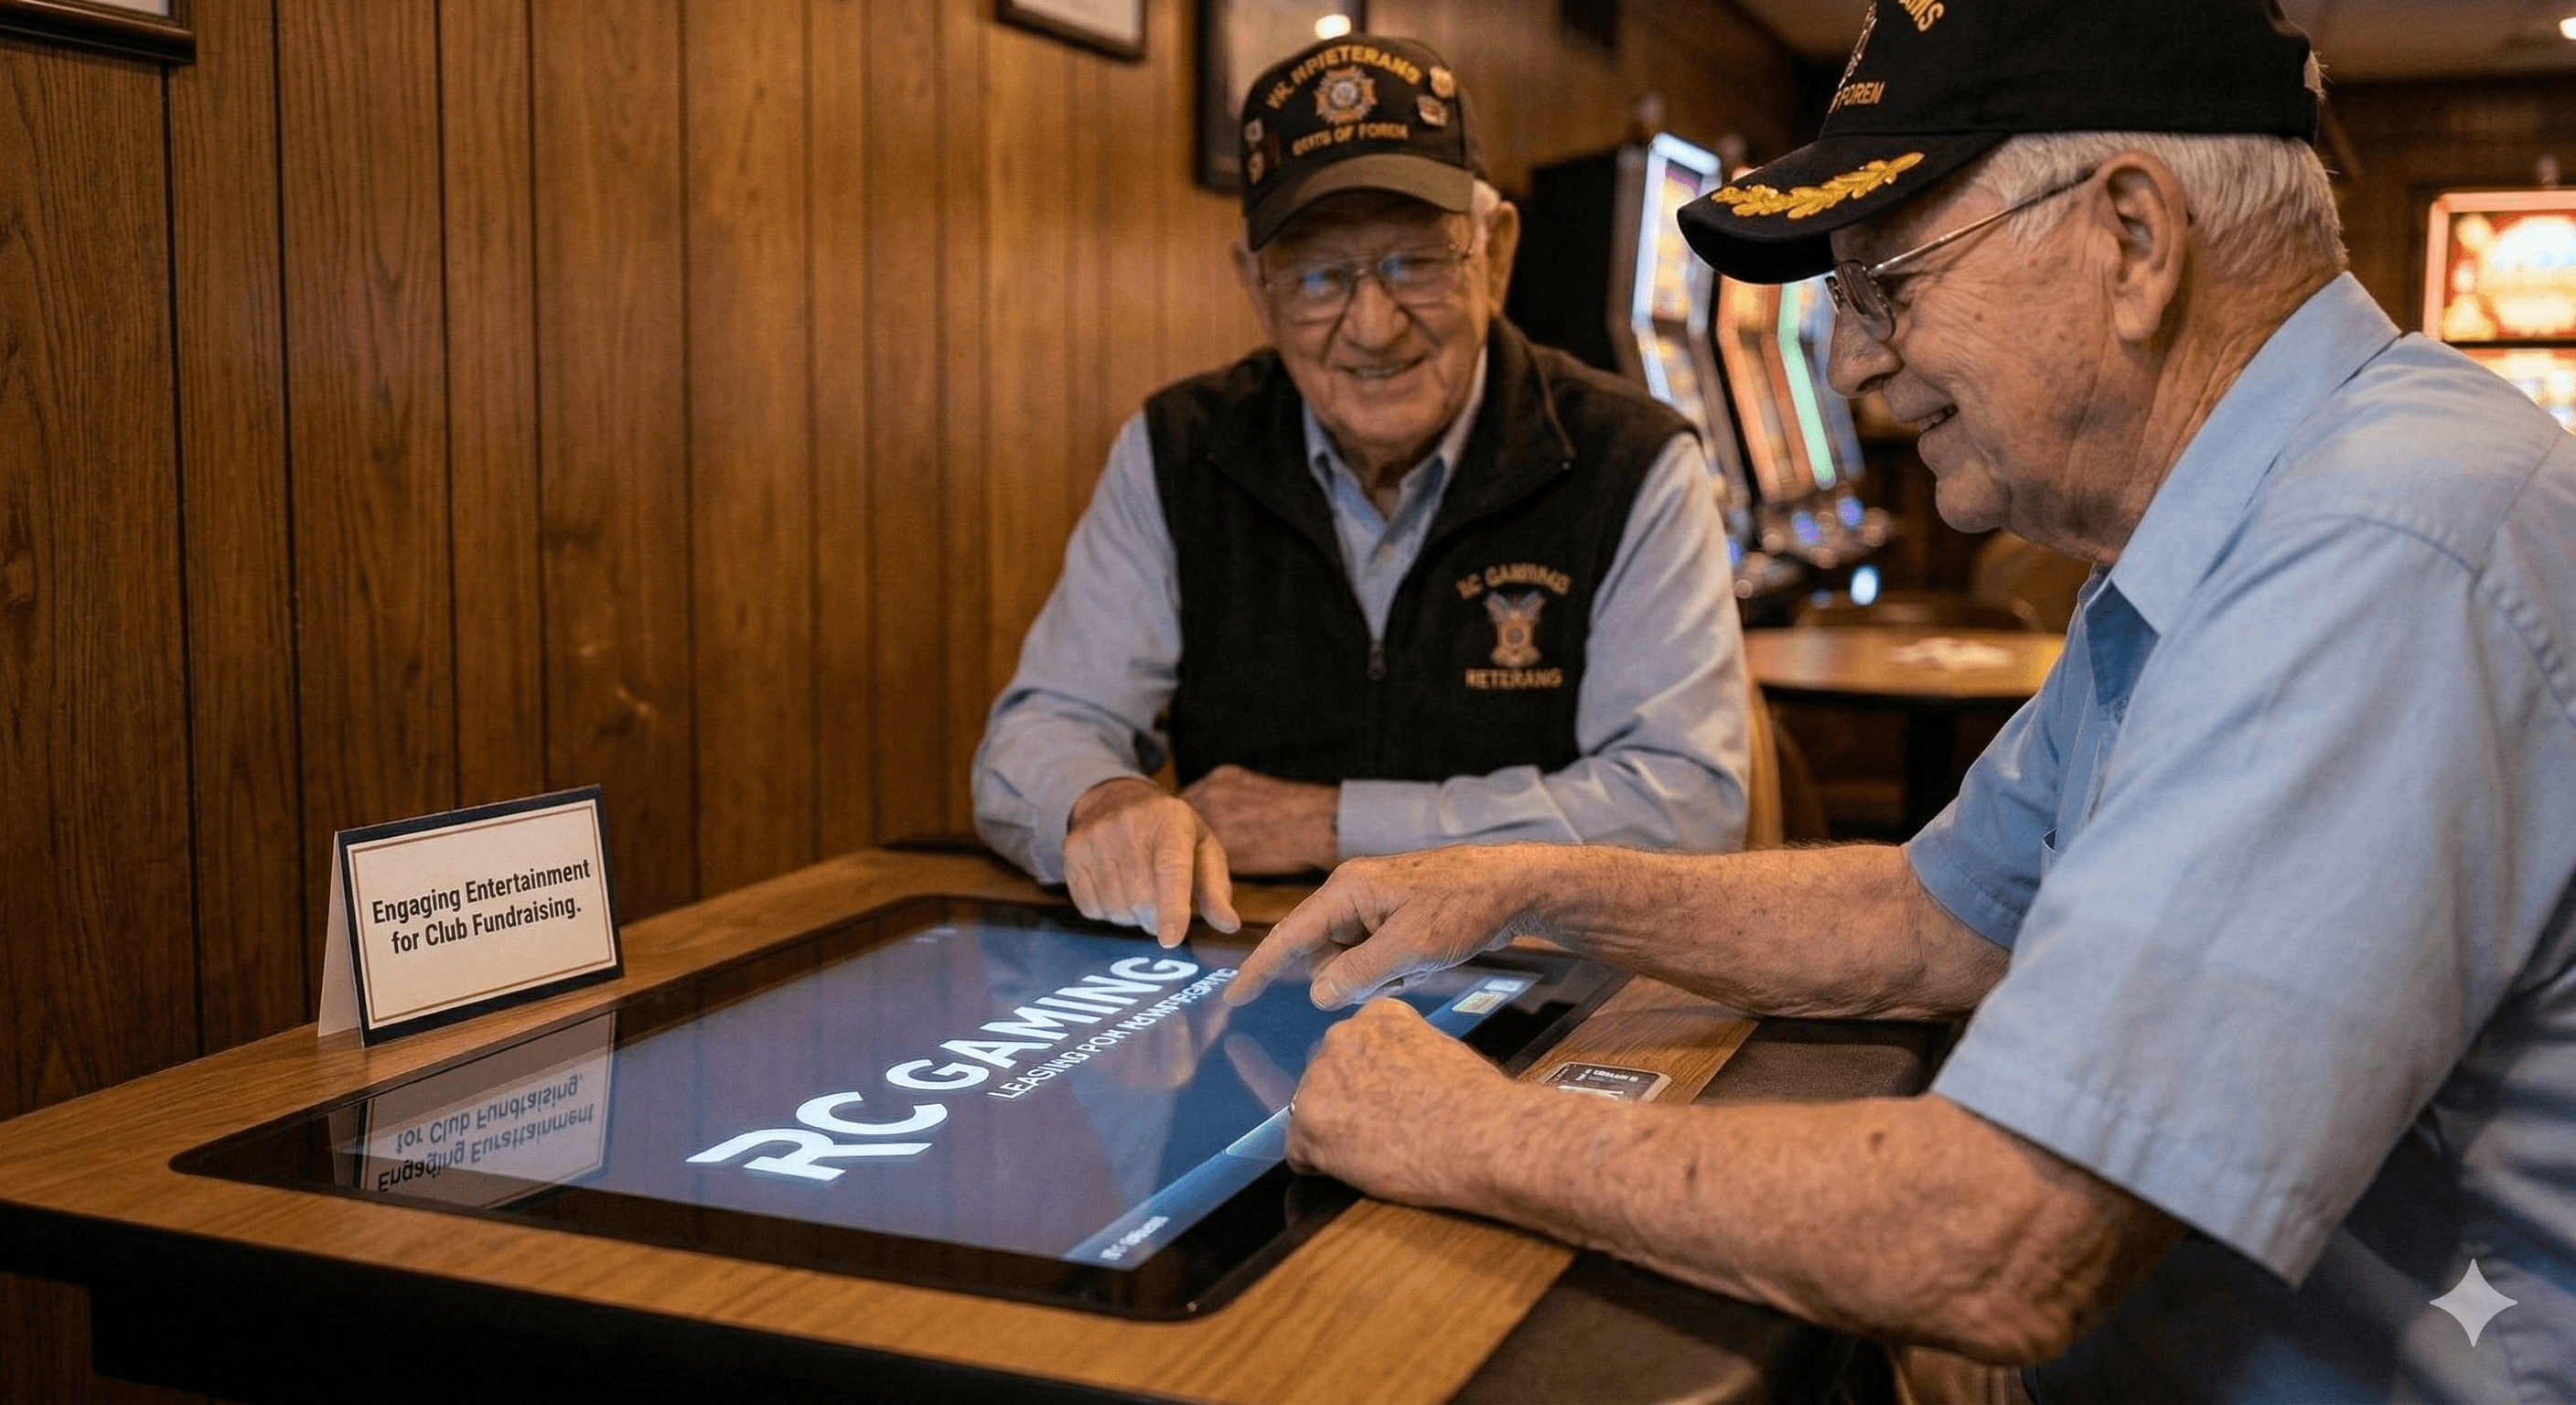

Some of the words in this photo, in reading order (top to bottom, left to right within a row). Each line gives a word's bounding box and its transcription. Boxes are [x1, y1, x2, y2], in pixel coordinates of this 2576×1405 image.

[371, 888, 461, 924] Engaging
[465, 859, 591, 904] Entertainment
[391, 930, 420, 954] for
[424, 917, 468, 947] Club
[473, 896, 582, 937] Fundraising.
[685, 1091, 948, 1182] RC
[885, 956, 1199, 1091] GAMING
